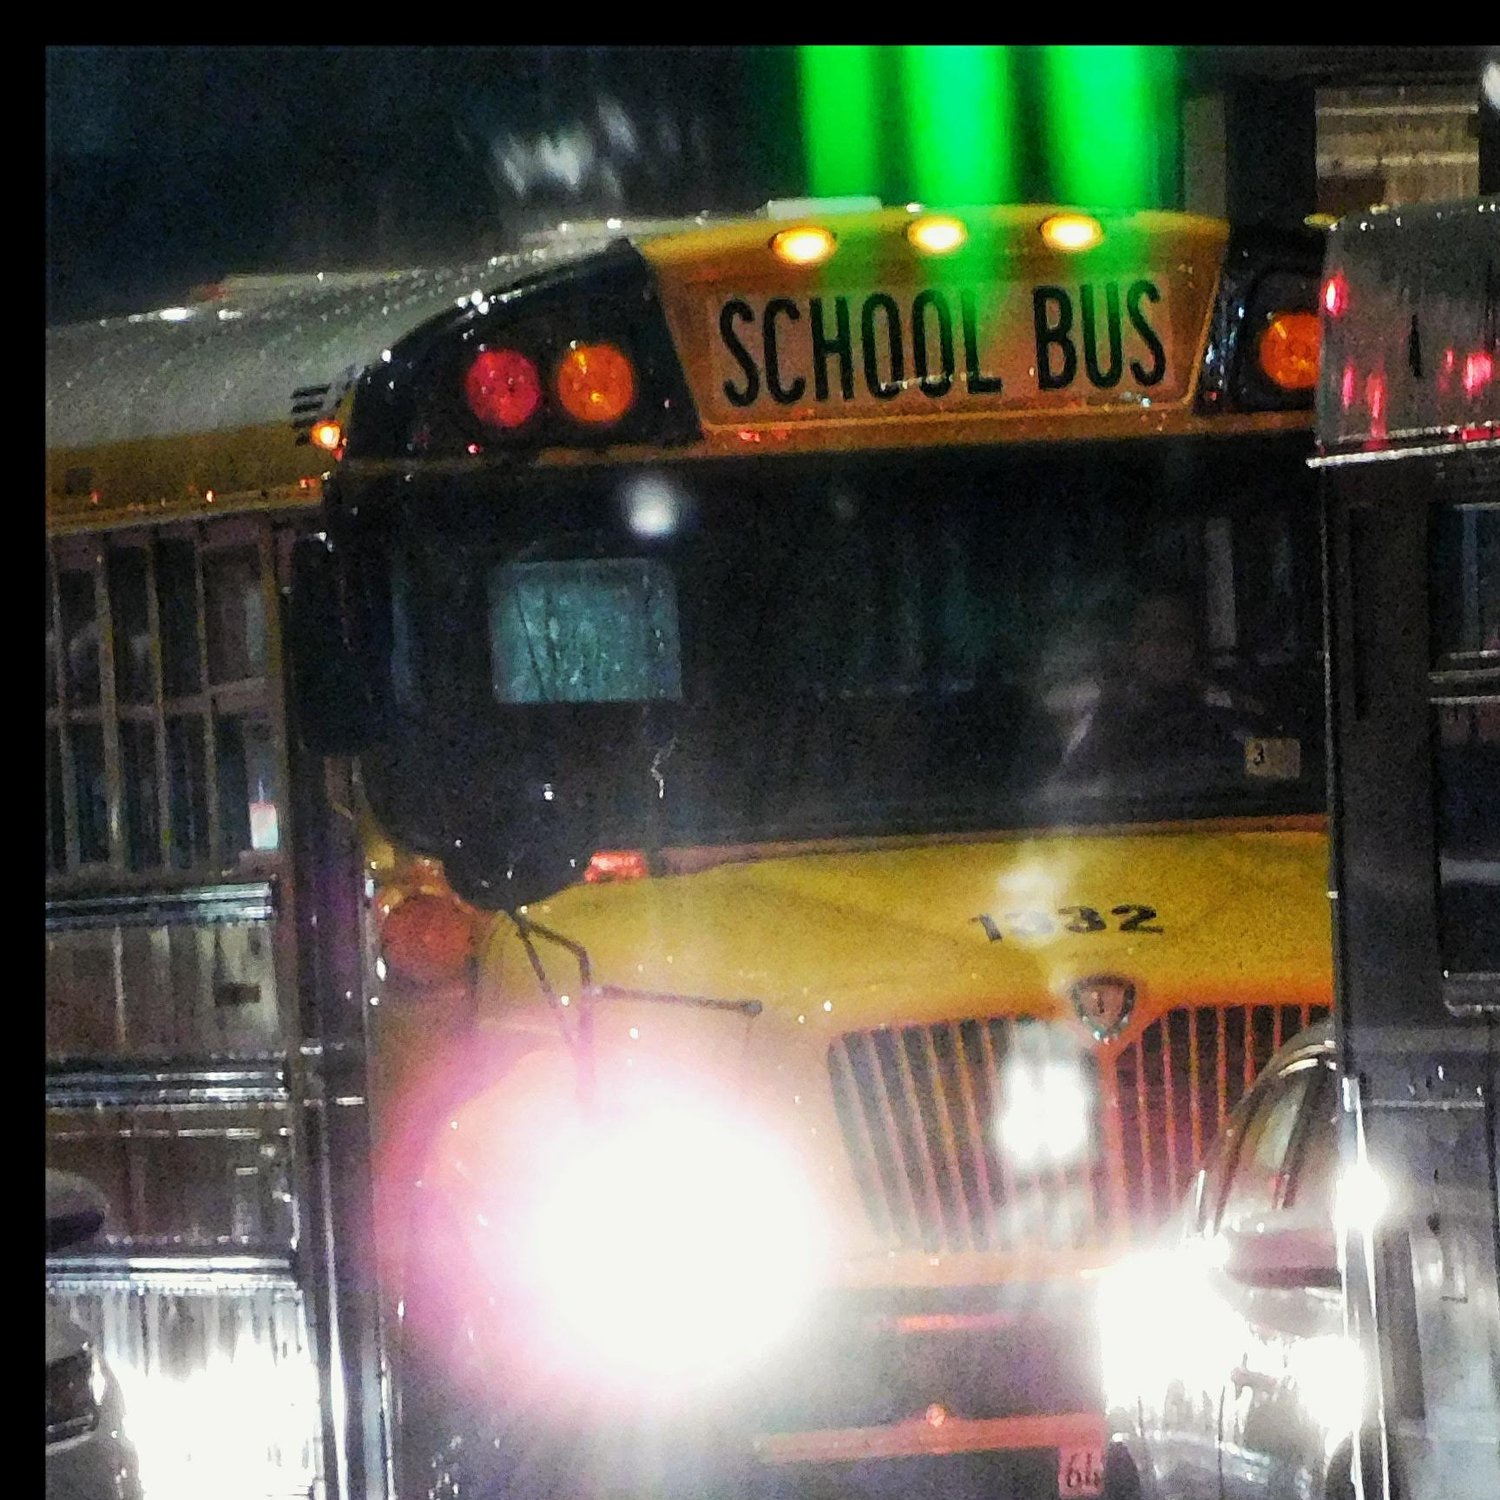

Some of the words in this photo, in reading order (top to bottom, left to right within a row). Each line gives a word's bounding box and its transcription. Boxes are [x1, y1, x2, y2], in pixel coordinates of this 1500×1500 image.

[718, 287, 1003, 407] SCHOOL
[1032, 279, 1168, 390] BUS
[967, 903, 1164, 943] 1332
